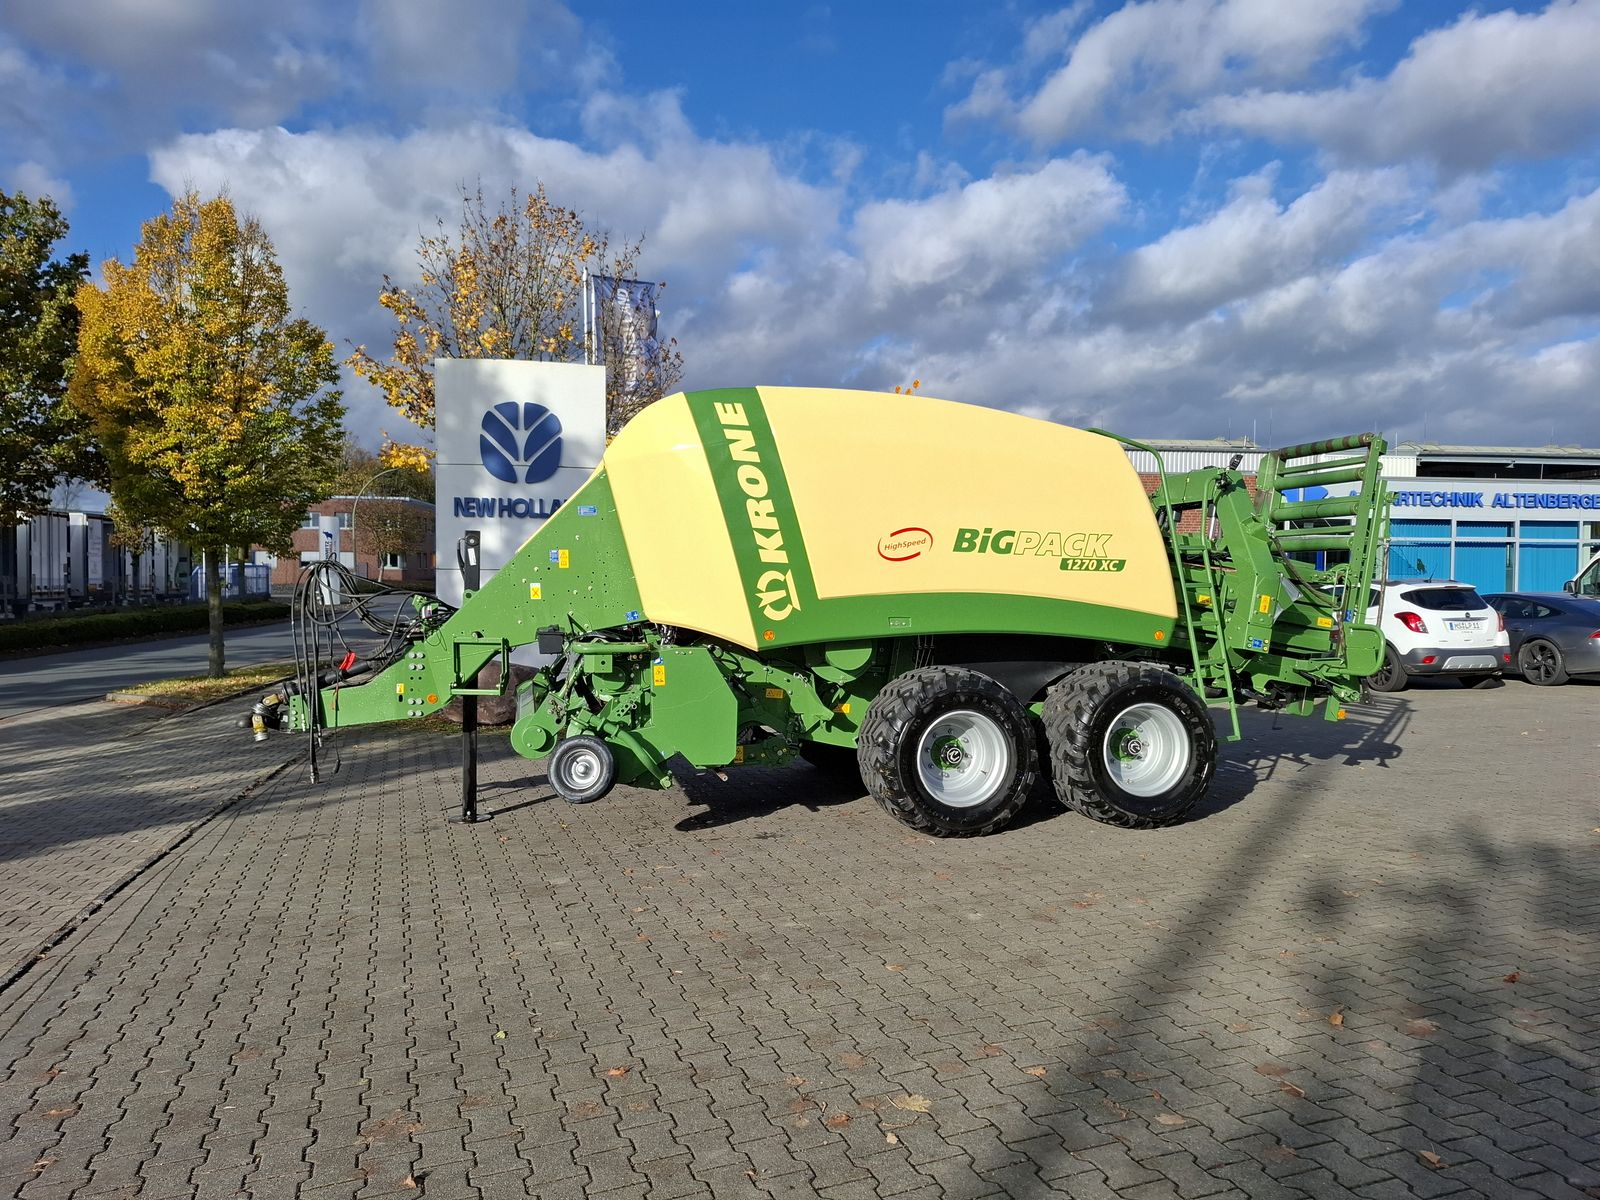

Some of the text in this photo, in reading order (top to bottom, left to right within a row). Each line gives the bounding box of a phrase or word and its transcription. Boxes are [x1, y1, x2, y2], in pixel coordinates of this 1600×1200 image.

[713, 402, 789, 564] KRONE
[453, 497, 568, 519] NEW HOLLA
[1350, 490, 1600, 510] RTECHNIK ALTENBERGE
[884, 537, 927, 551] HighSpeed
[1066, 559, 1118, 571] 1270 XC
